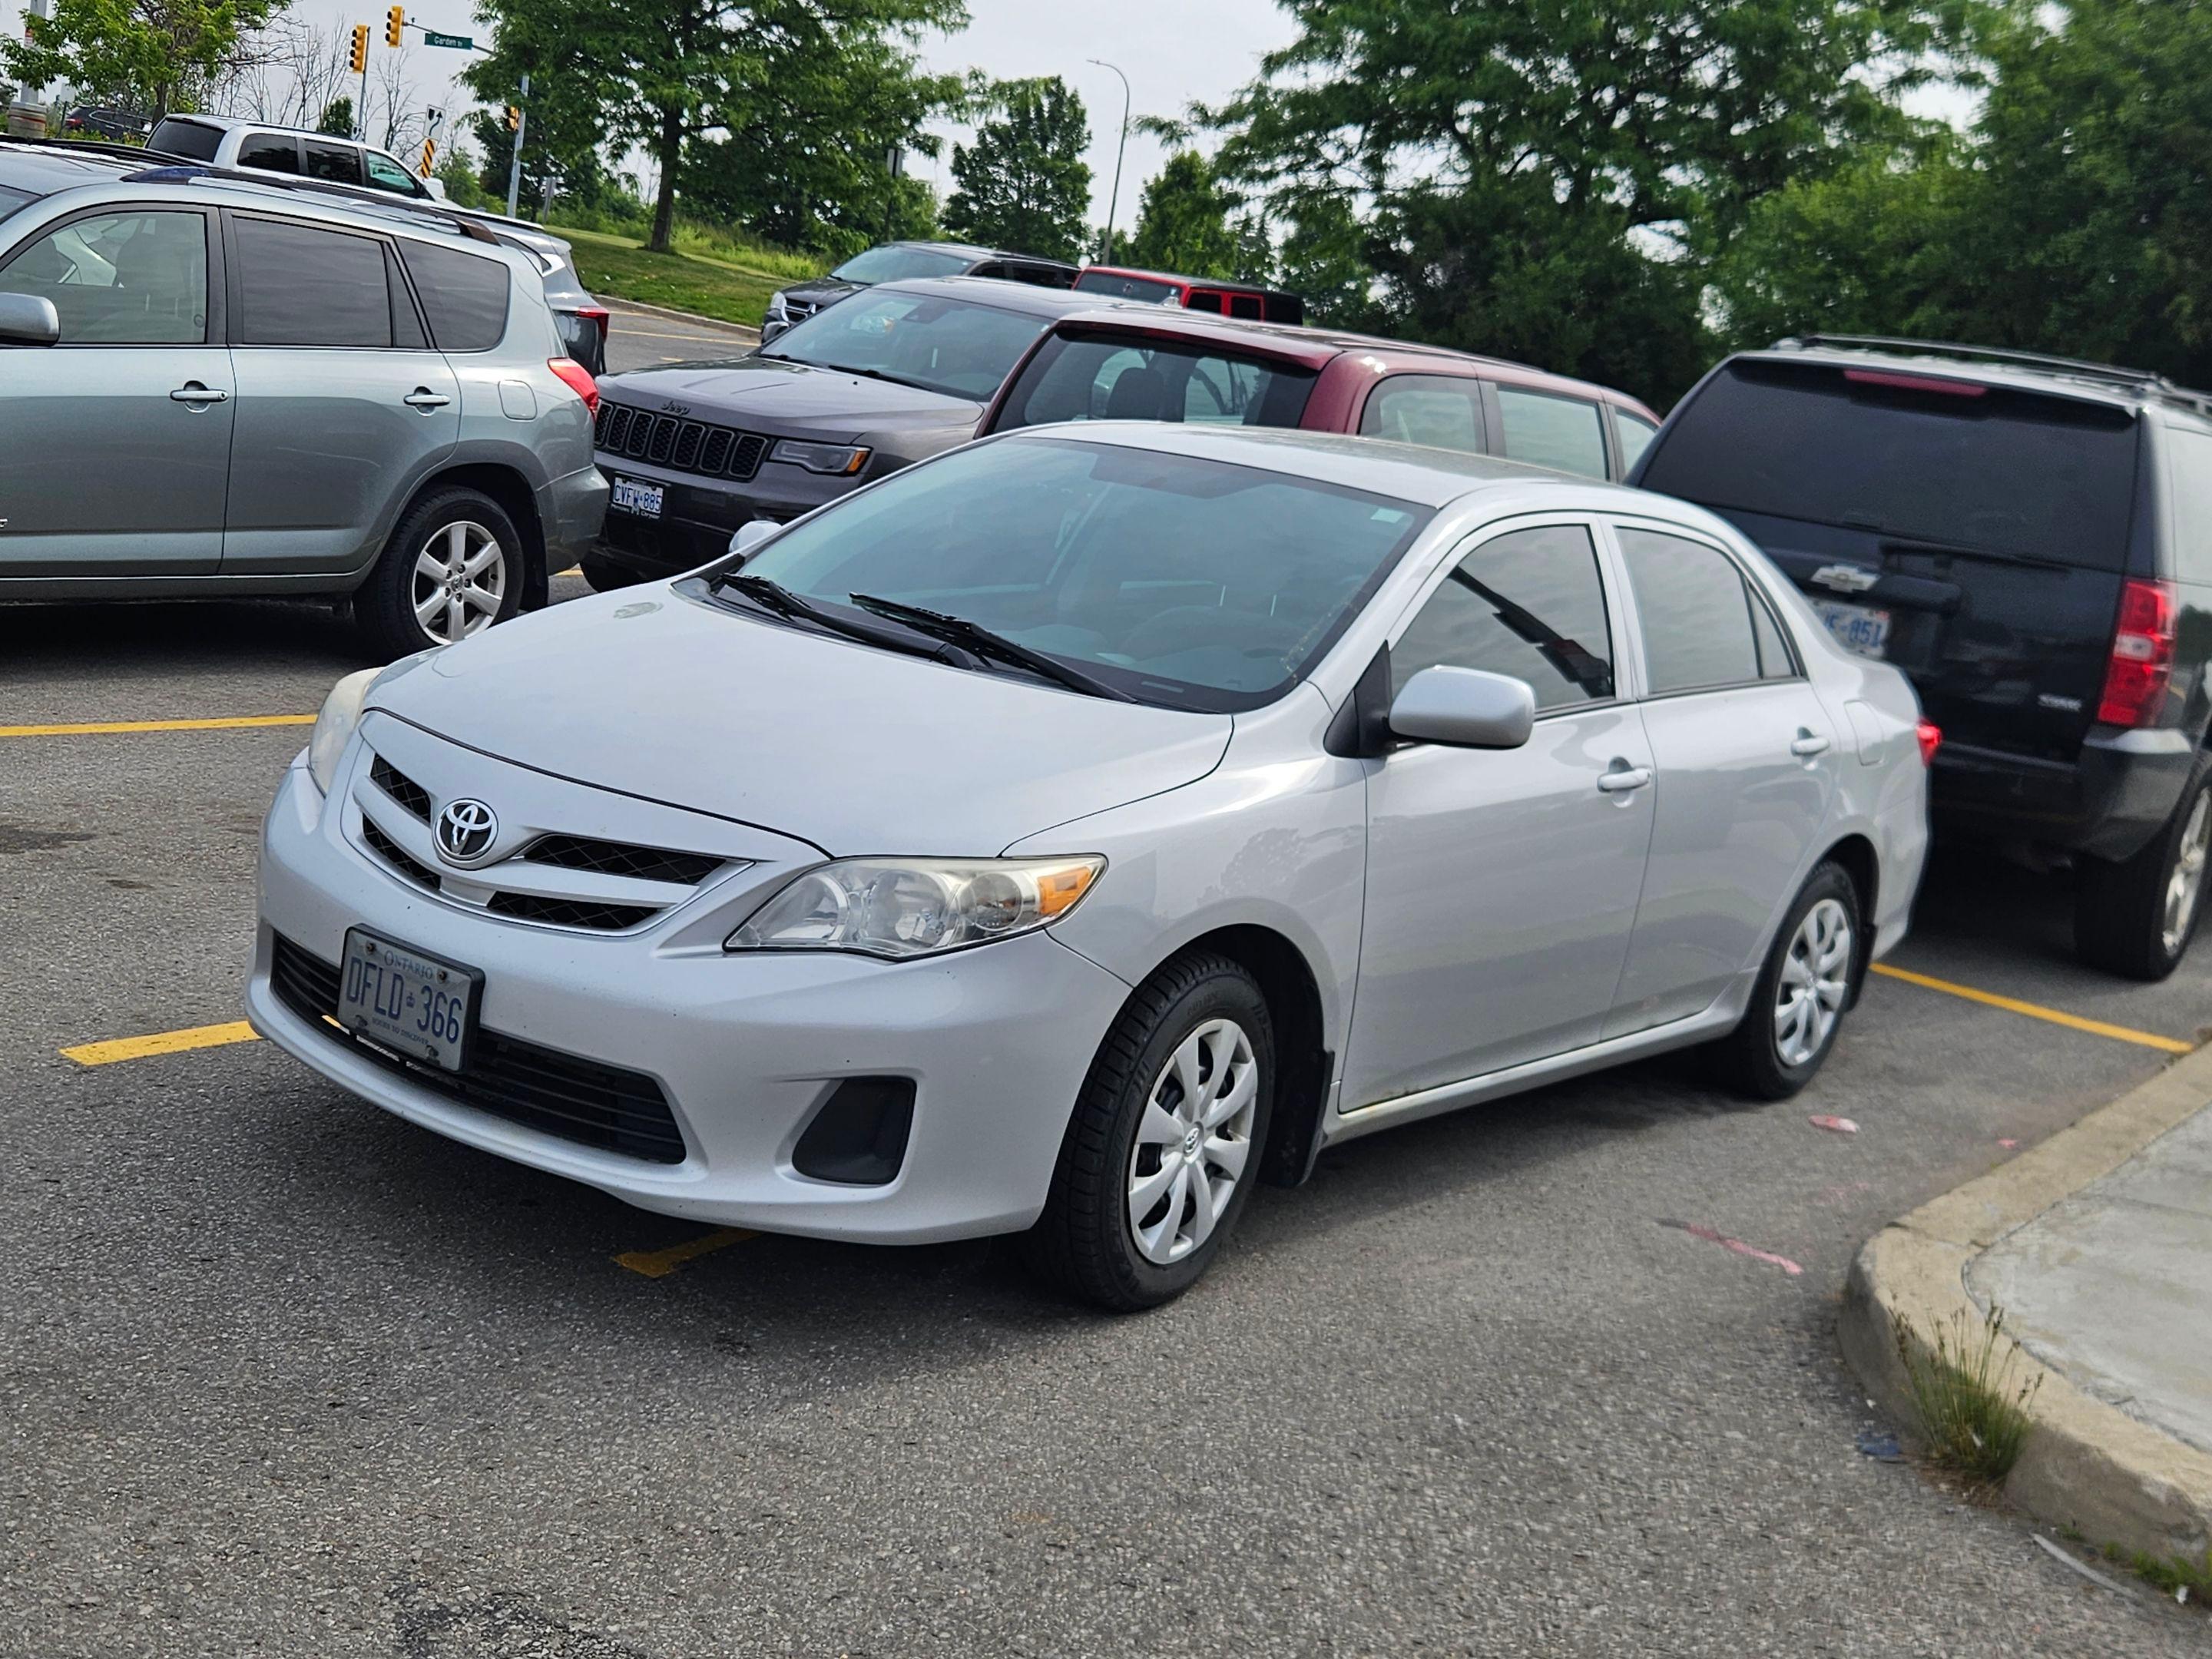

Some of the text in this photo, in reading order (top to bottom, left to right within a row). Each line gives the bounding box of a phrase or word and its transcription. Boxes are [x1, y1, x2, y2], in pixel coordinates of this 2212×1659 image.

[434, 35, 457, 46] Garden
[661, 400, 691, 416] Jeep
[643, 492, 663, 512] 885
[384, 950, 433, 980] ONTARIO
[346, 957, 463, 1045] DFLD 366
